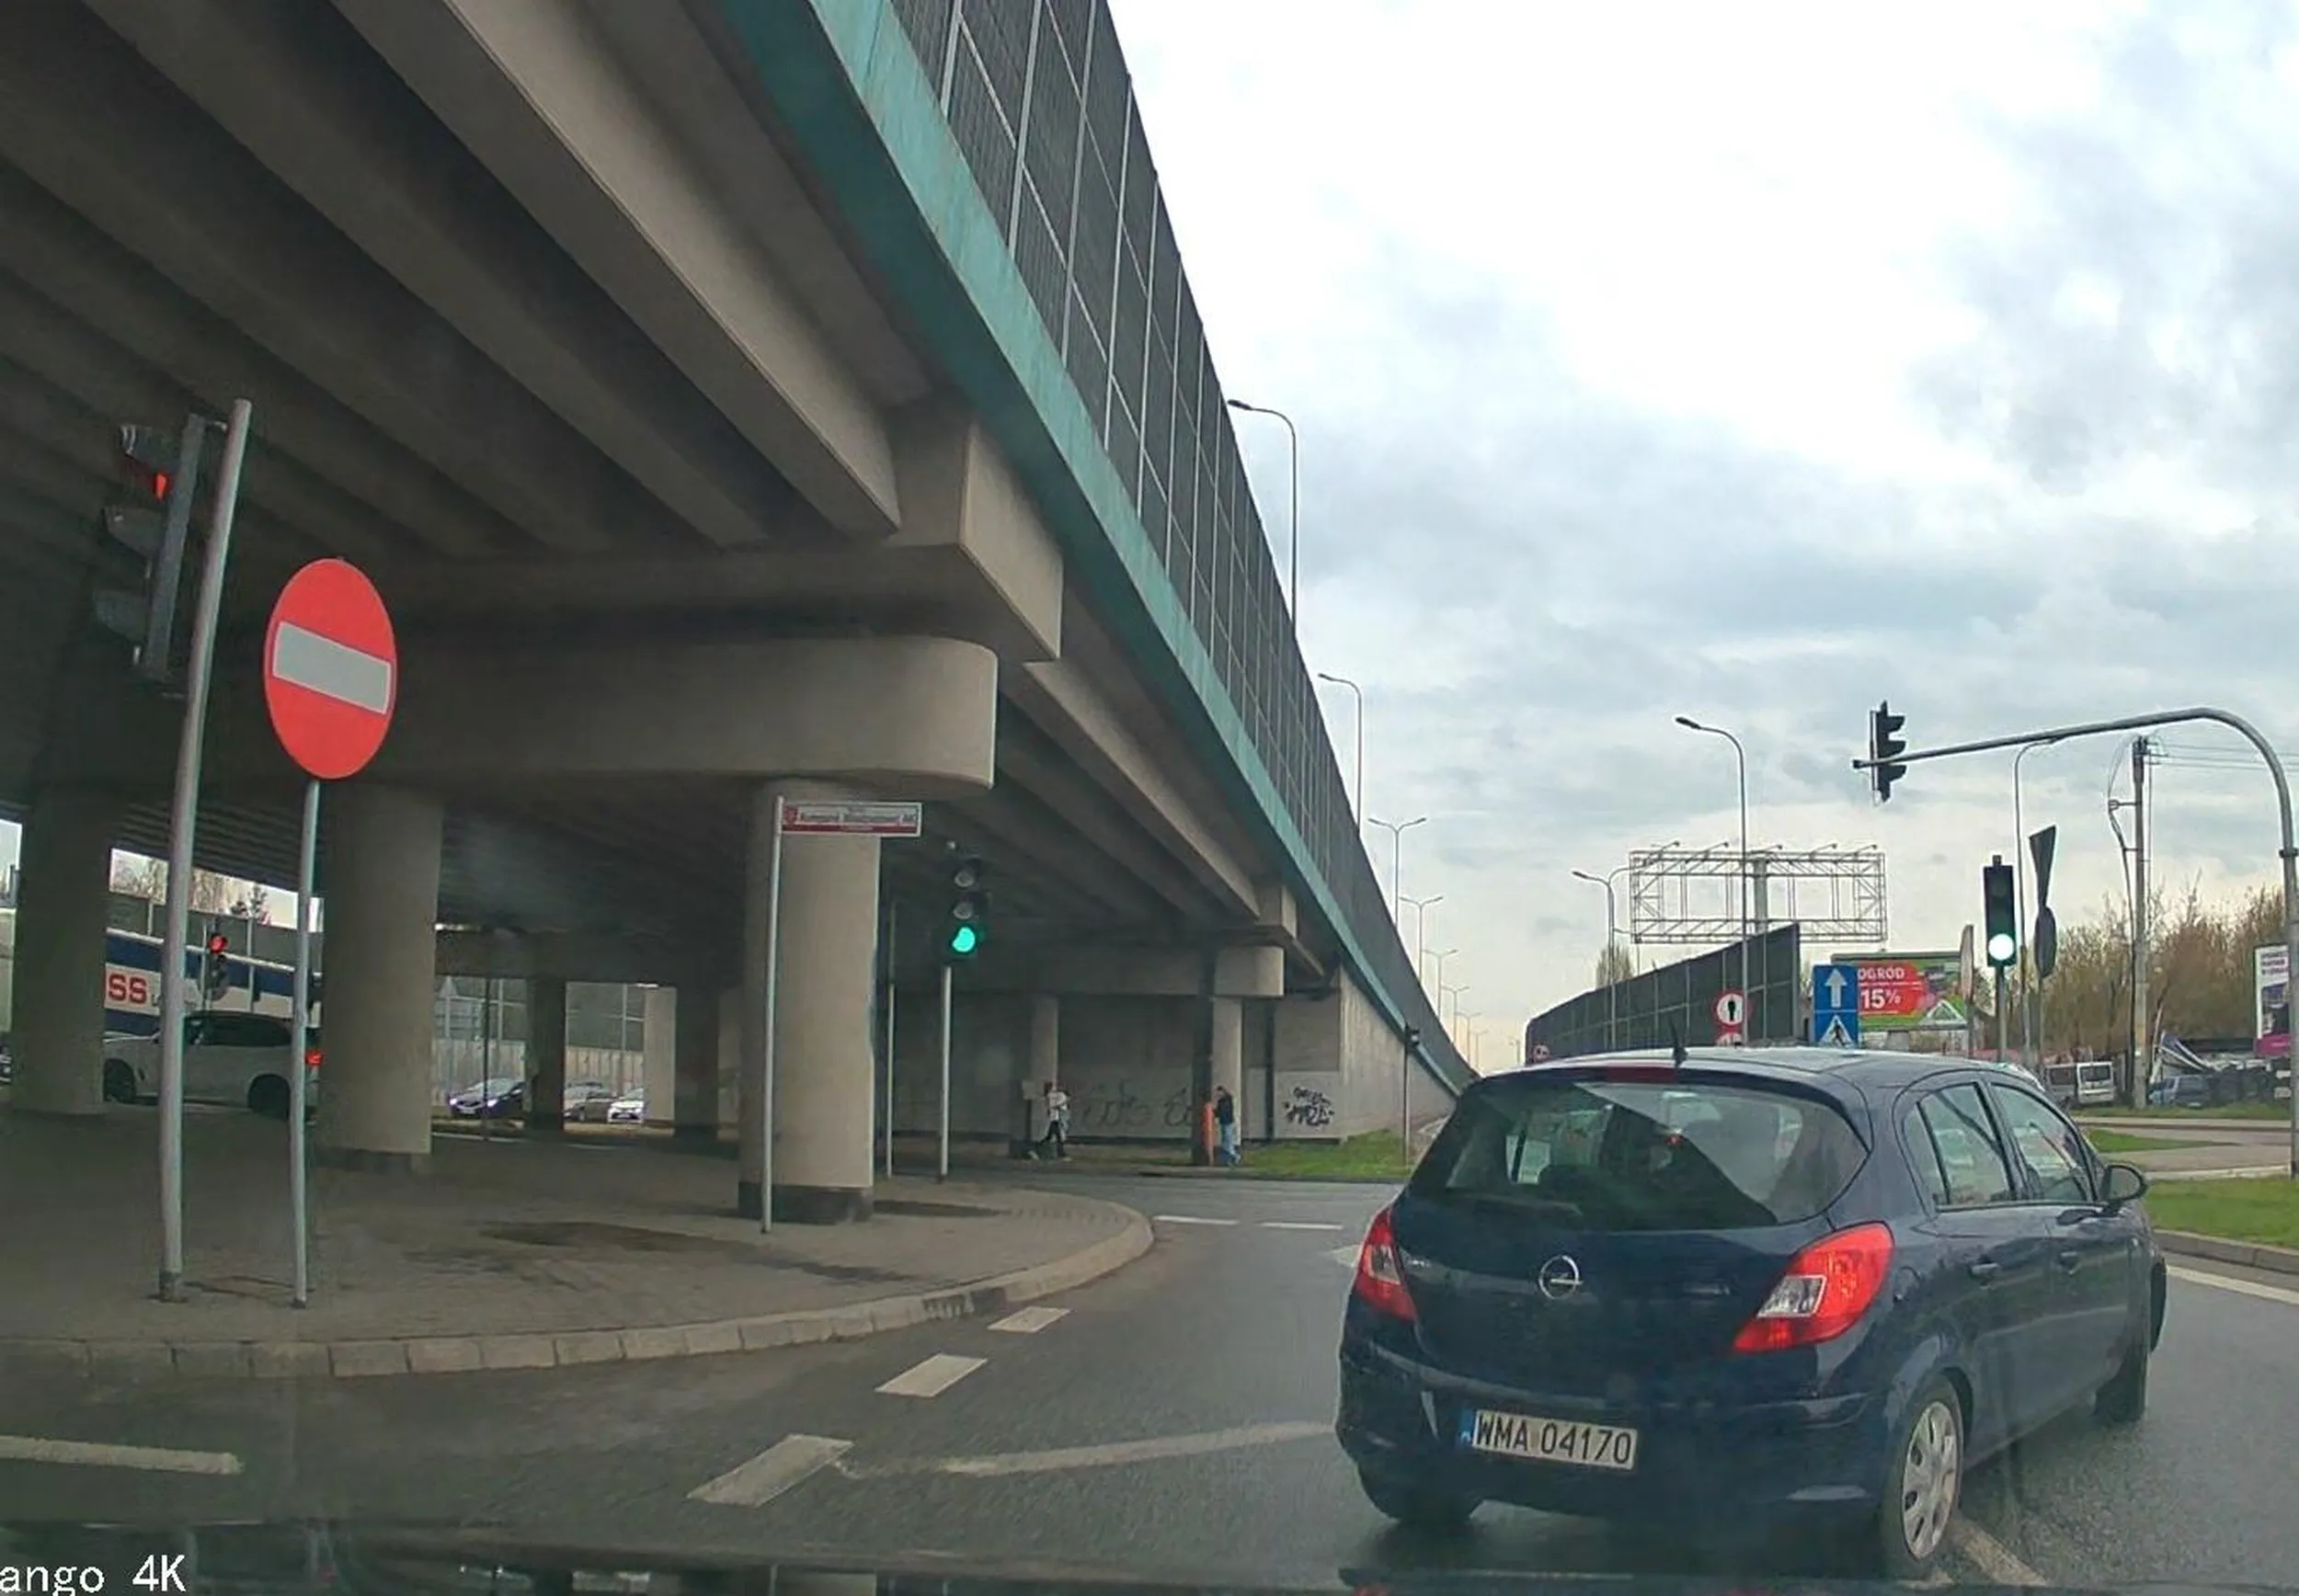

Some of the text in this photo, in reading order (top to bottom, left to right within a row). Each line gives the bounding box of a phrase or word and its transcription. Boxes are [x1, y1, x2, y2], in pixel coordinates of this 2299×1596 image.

[1858, 966, 1905, 980] OGRÓD
[1476, 1413, 1632, 1465] WMA 04170
